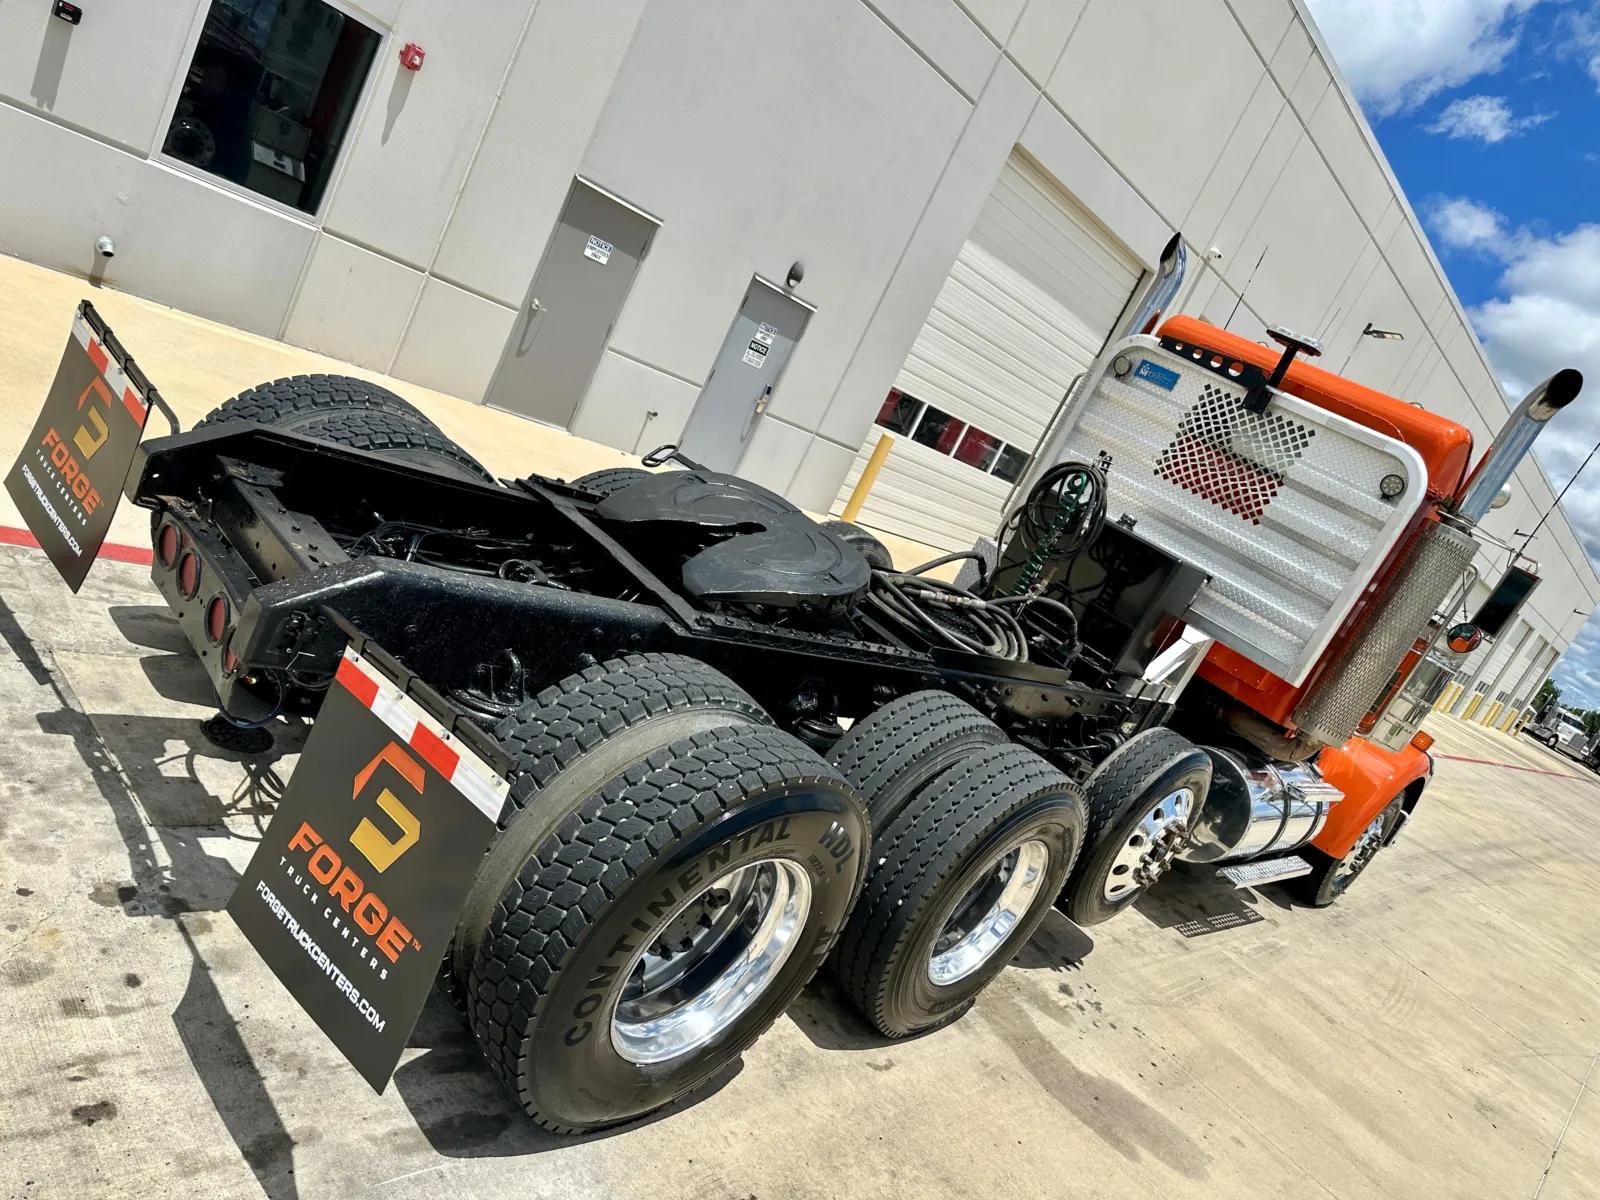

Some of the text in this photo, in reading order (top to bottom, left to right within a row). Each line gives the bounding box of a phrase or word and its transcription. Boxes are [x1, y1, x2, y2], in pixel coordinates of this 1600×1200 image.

[590, 237, 612, 252] NOTICE
[751, 342, 767, 354] NOTICE
[21, 464, 83, 557] FORGETRUCKCENTERS.COM
[36, 448, 86, 526] TRUCK CENTERS
[41, 427, 102, 515] FORGE
[279, 855, 388, 981] TRUCK CENTERS
[287, 821, 413, 964] FORGE
[564, 817, 793, 1047] CONTINENTAL
[255, 880, 386, 1033] FORGETRUCKCENTERS.COM
